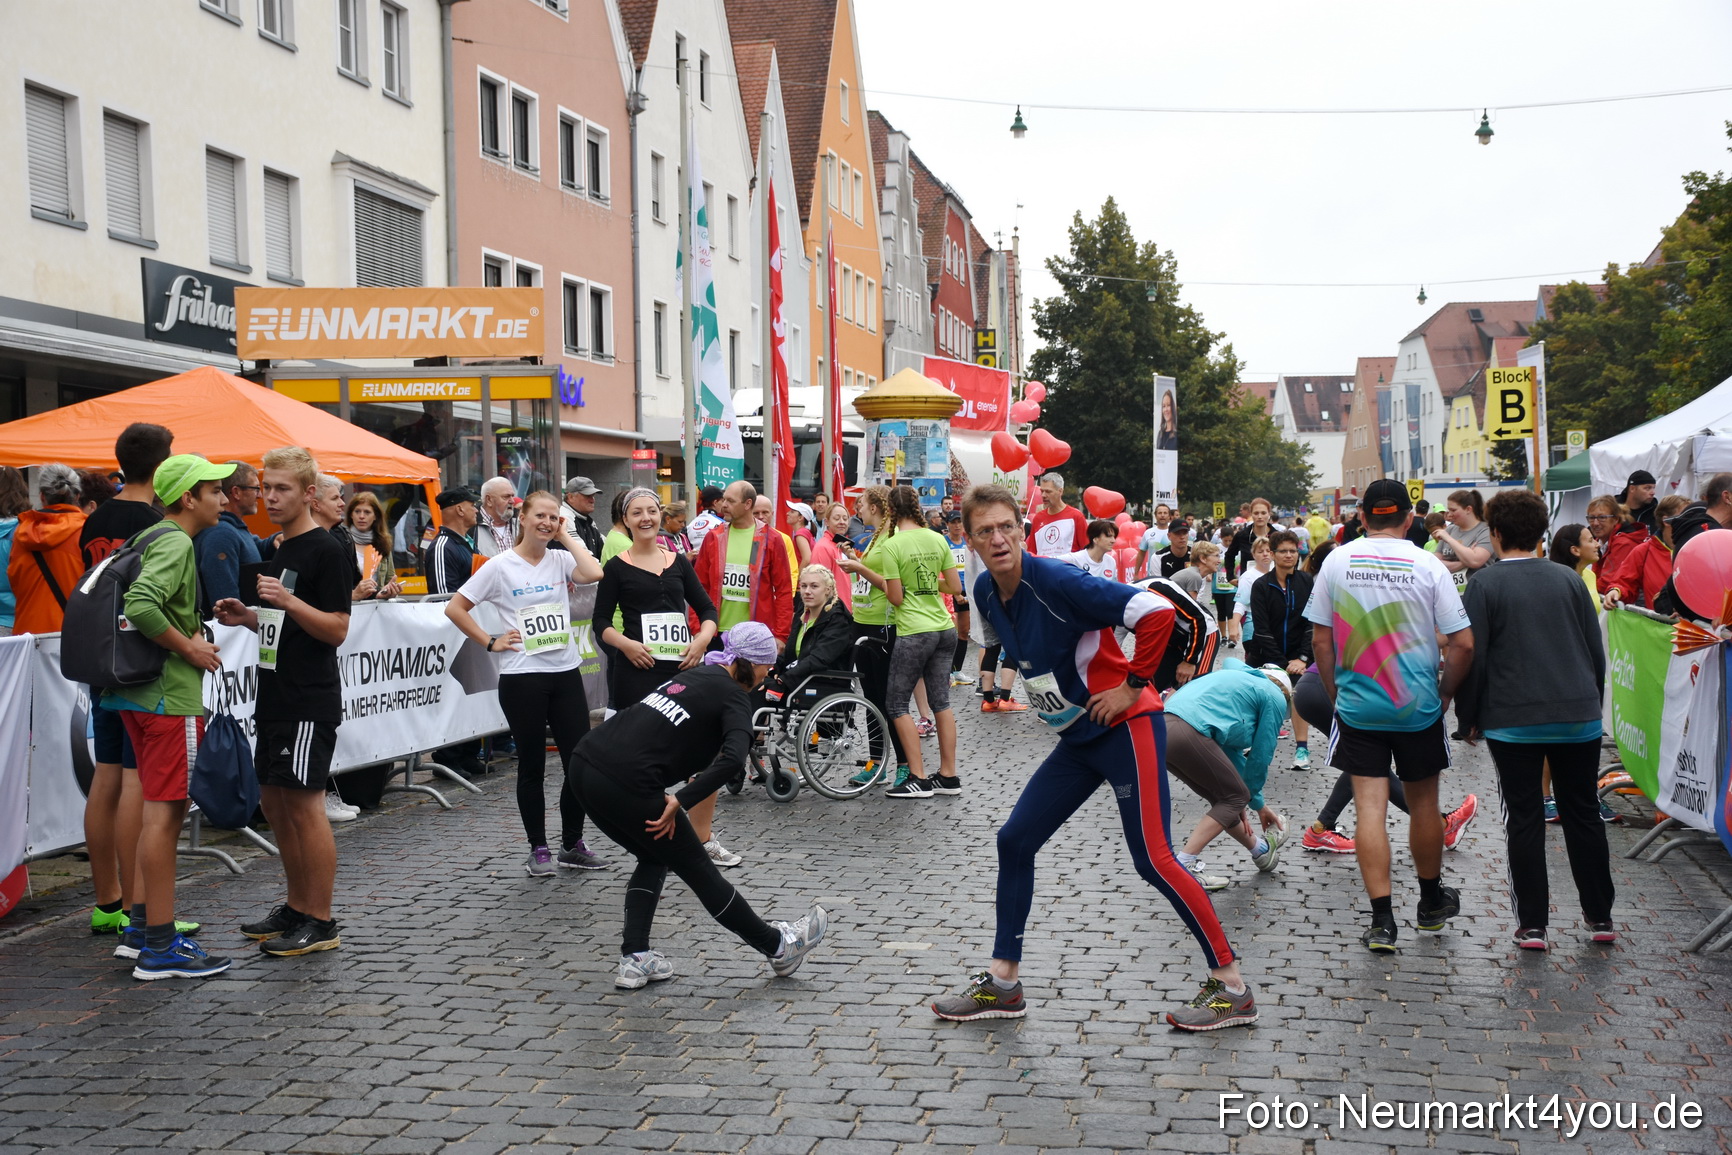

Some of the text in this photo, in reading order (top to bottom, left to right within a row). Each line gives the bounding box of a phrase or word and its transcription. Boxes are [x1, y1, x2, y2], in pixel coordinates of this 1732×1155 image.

[247, 307, 529, 341] RUNMARKT.DE
[1493, 370, 1531, 384] Block
[362, 383, 471, 397] RUNMARKT.DE
[1500, 389, 1525, 424] B
[1410, 487, 1419, 500] C
[1216, 507, 1222, 516] D
[524, 614, 565, 636] 5007
[649, 624, 687, 643] 5160
[537, 636, 563, 646] Barbara
[660, 646, 680, 654] Carina
[352, 695, 378, 719] MEHR
[380, 685, 442, 713] FAHRFREUDE
